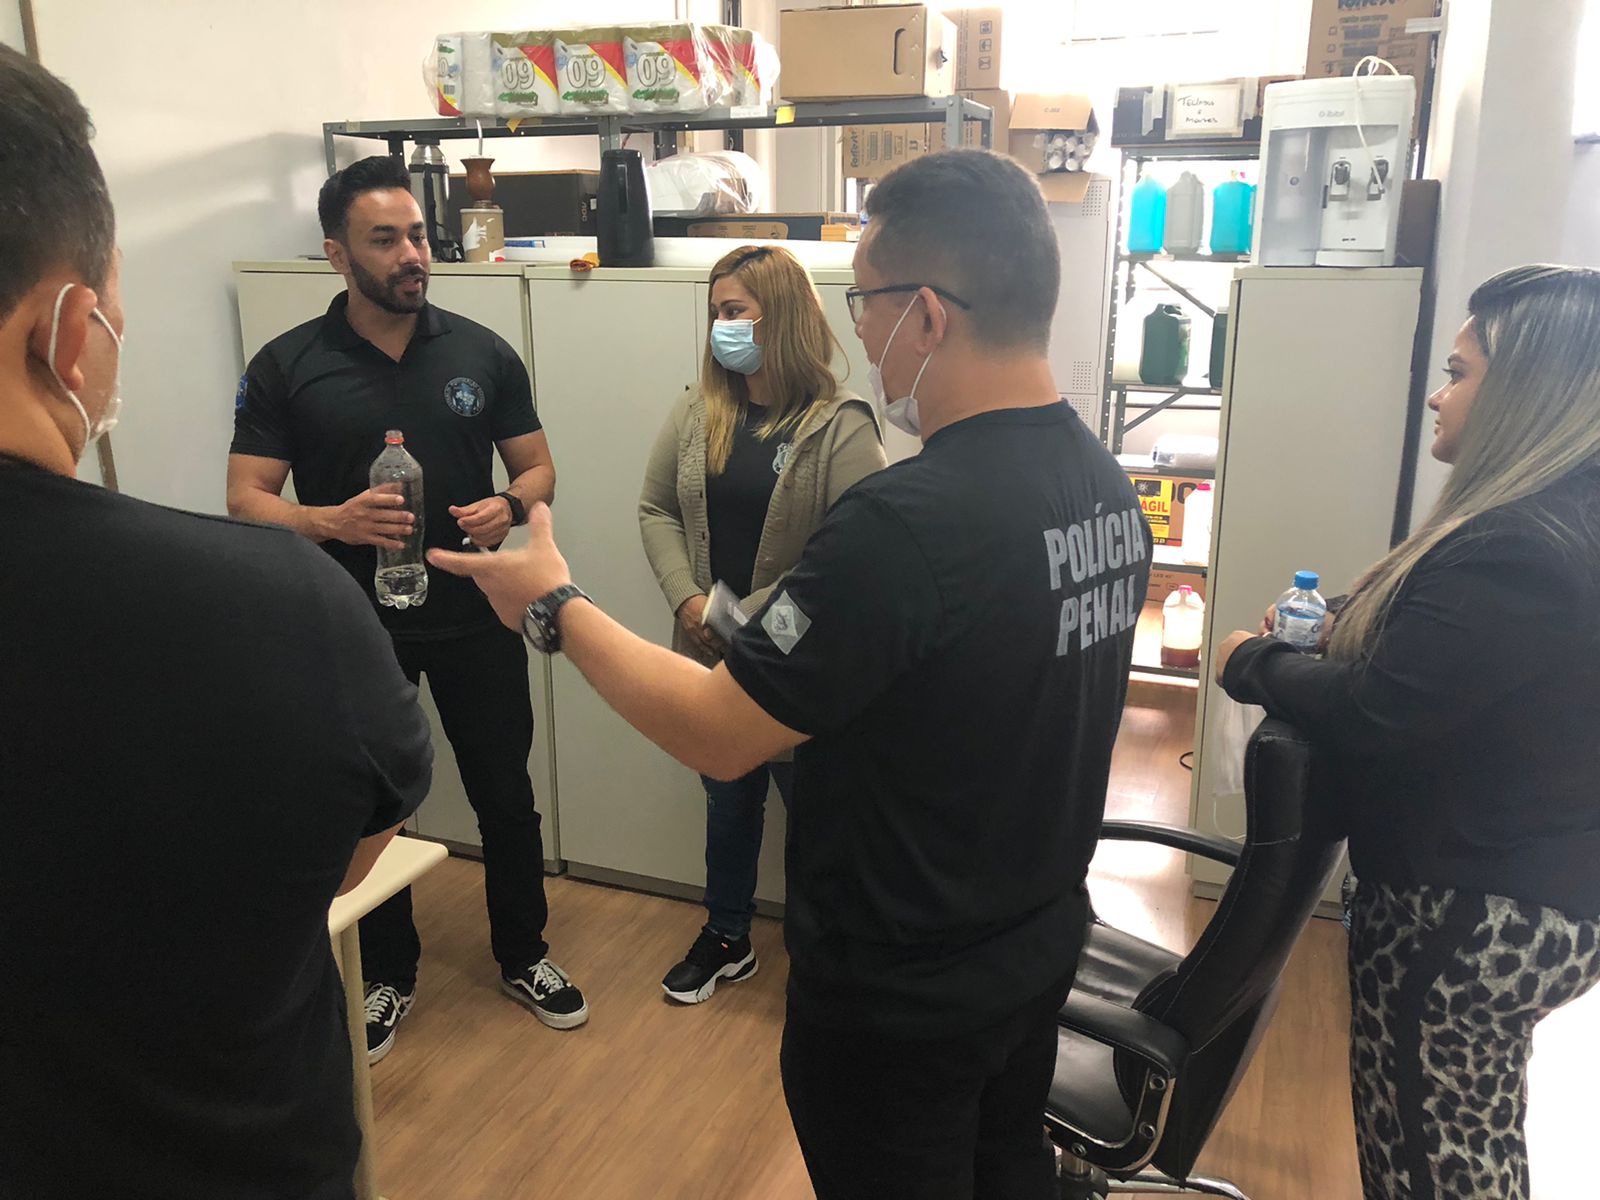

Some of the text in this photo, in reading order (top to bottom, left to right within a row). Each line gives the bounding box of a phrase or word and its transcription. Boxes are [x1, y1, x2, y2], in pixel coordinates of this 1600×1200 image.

[1141, 497, 1168, 513] ÁGIL
[1043, 502, 1146, 591] POLÍCIA
[1055, 574, 1137, 656] PENAL
